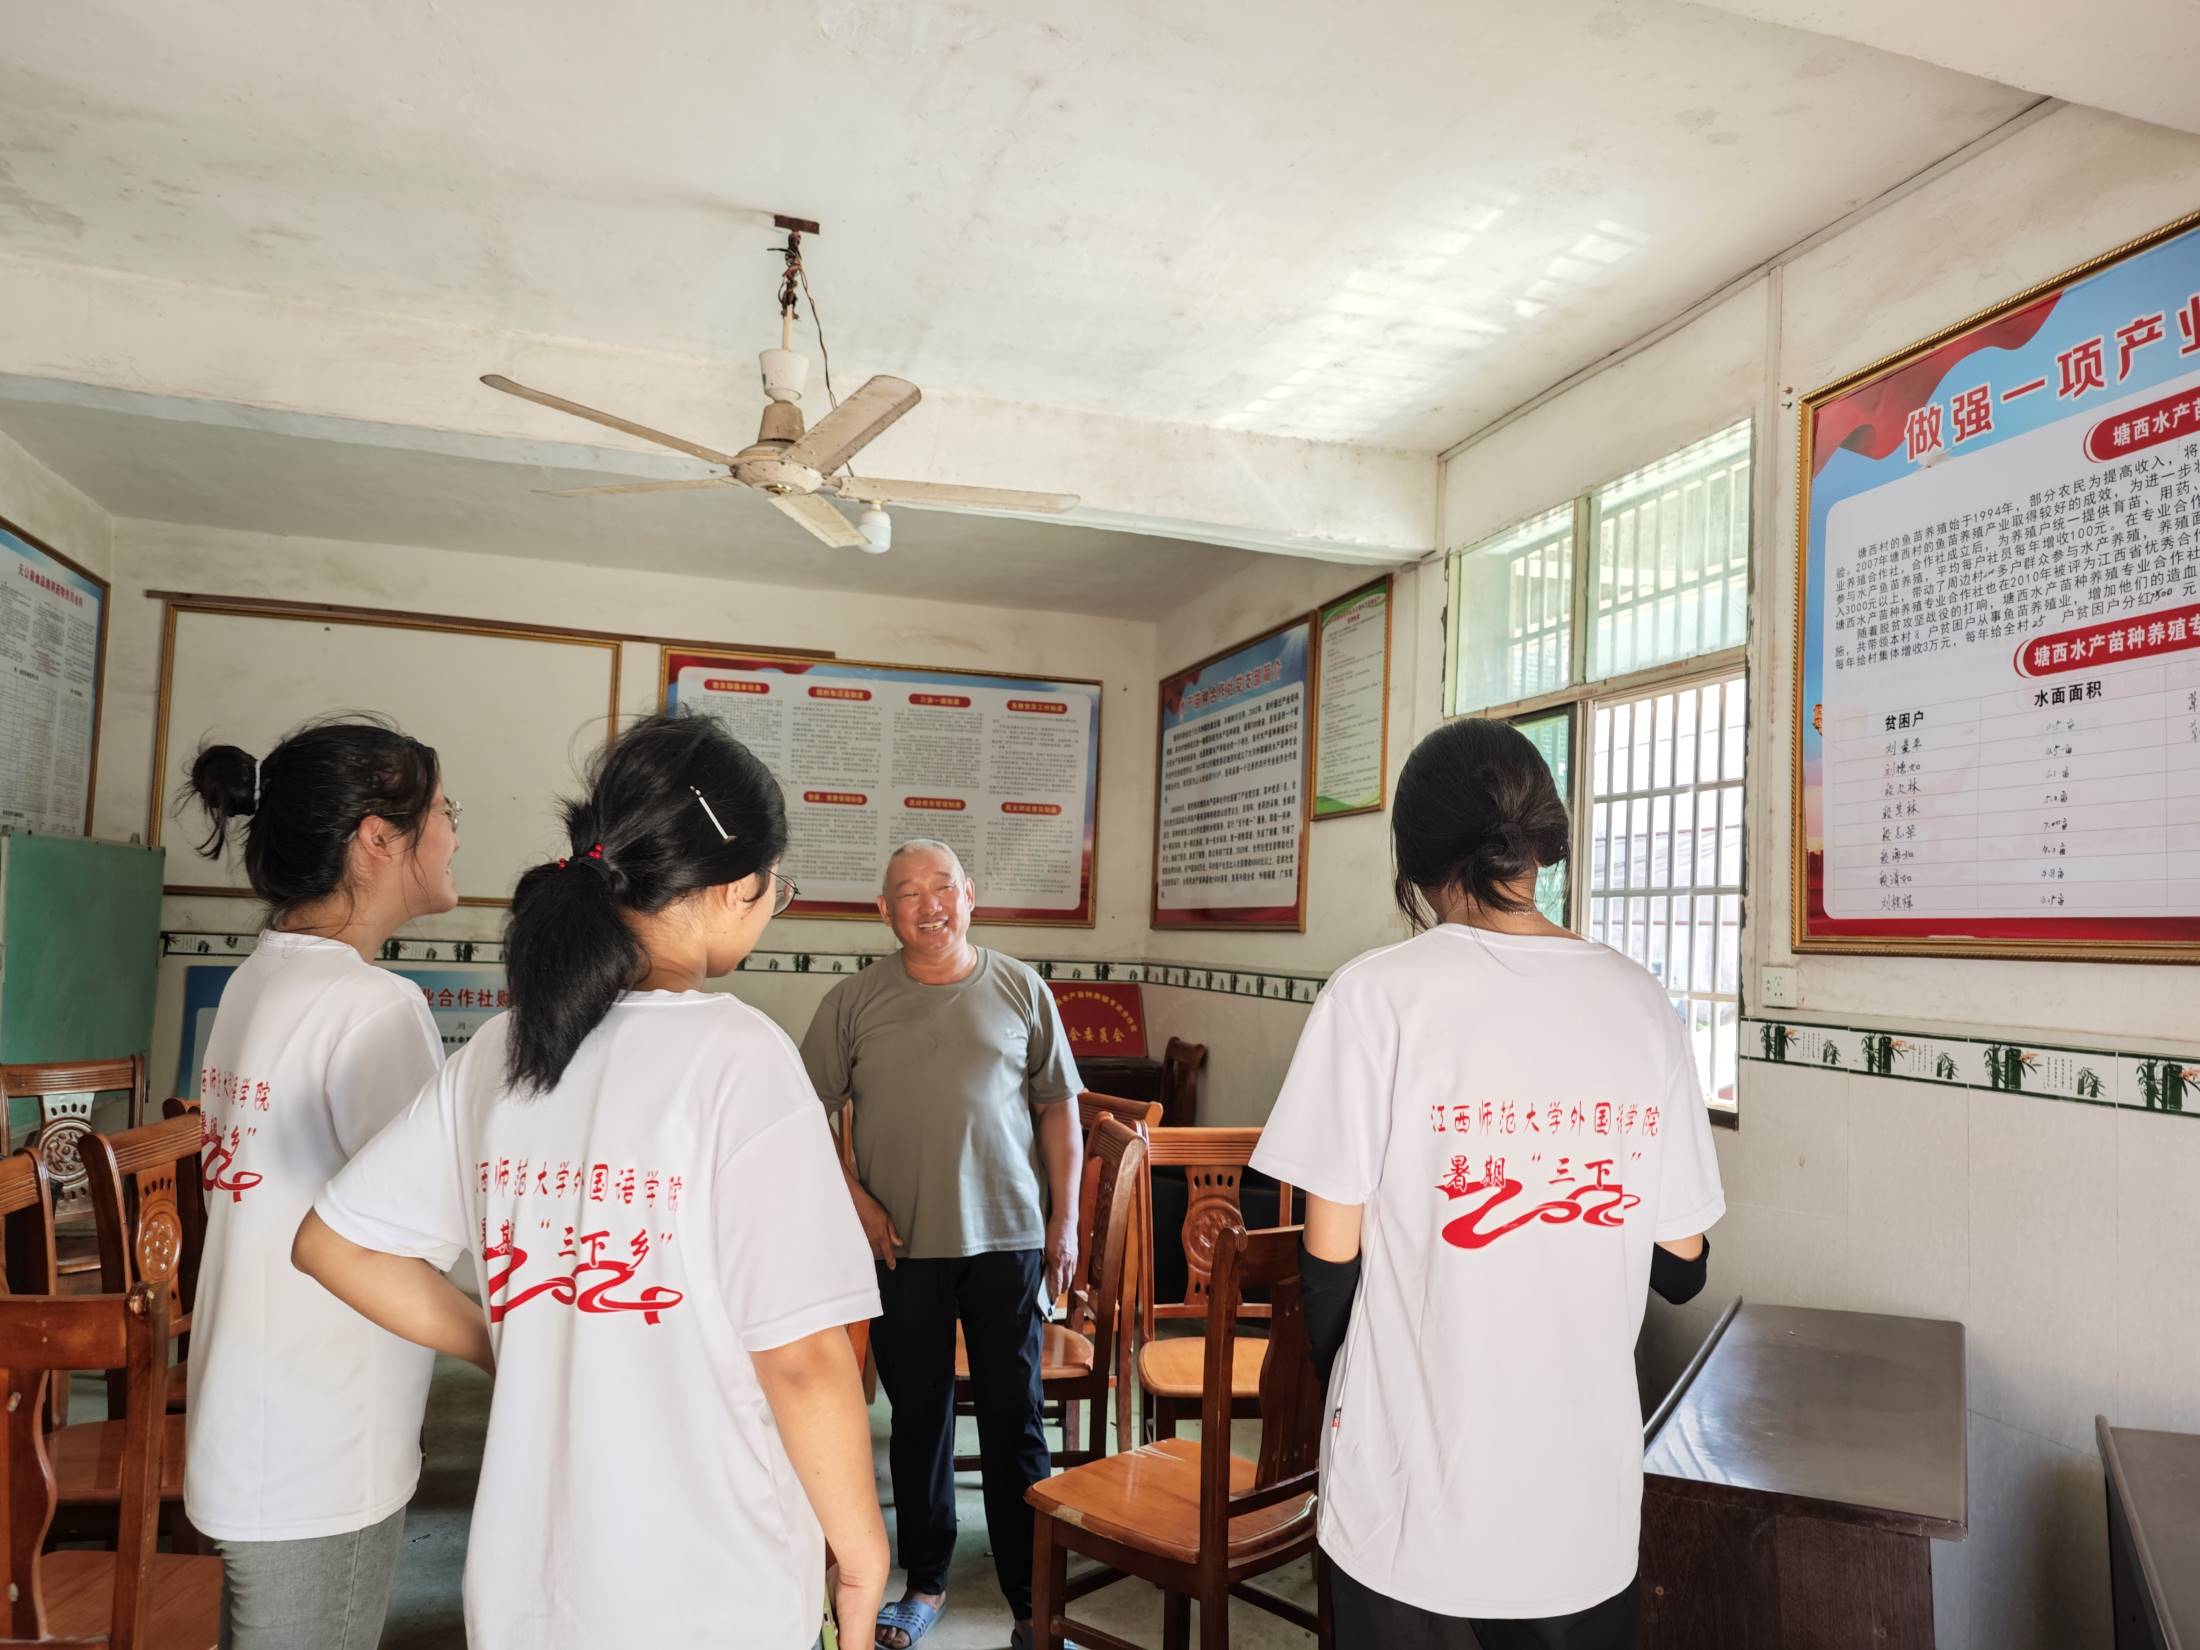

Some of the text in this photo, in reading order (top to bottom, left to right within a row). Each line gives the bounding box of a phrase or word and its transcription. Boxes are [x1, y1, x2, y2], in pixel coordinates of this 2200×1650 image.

[2034, 681, 2101, 707] 水面面积
[1885, 710, 1924, 732] 贫困户
